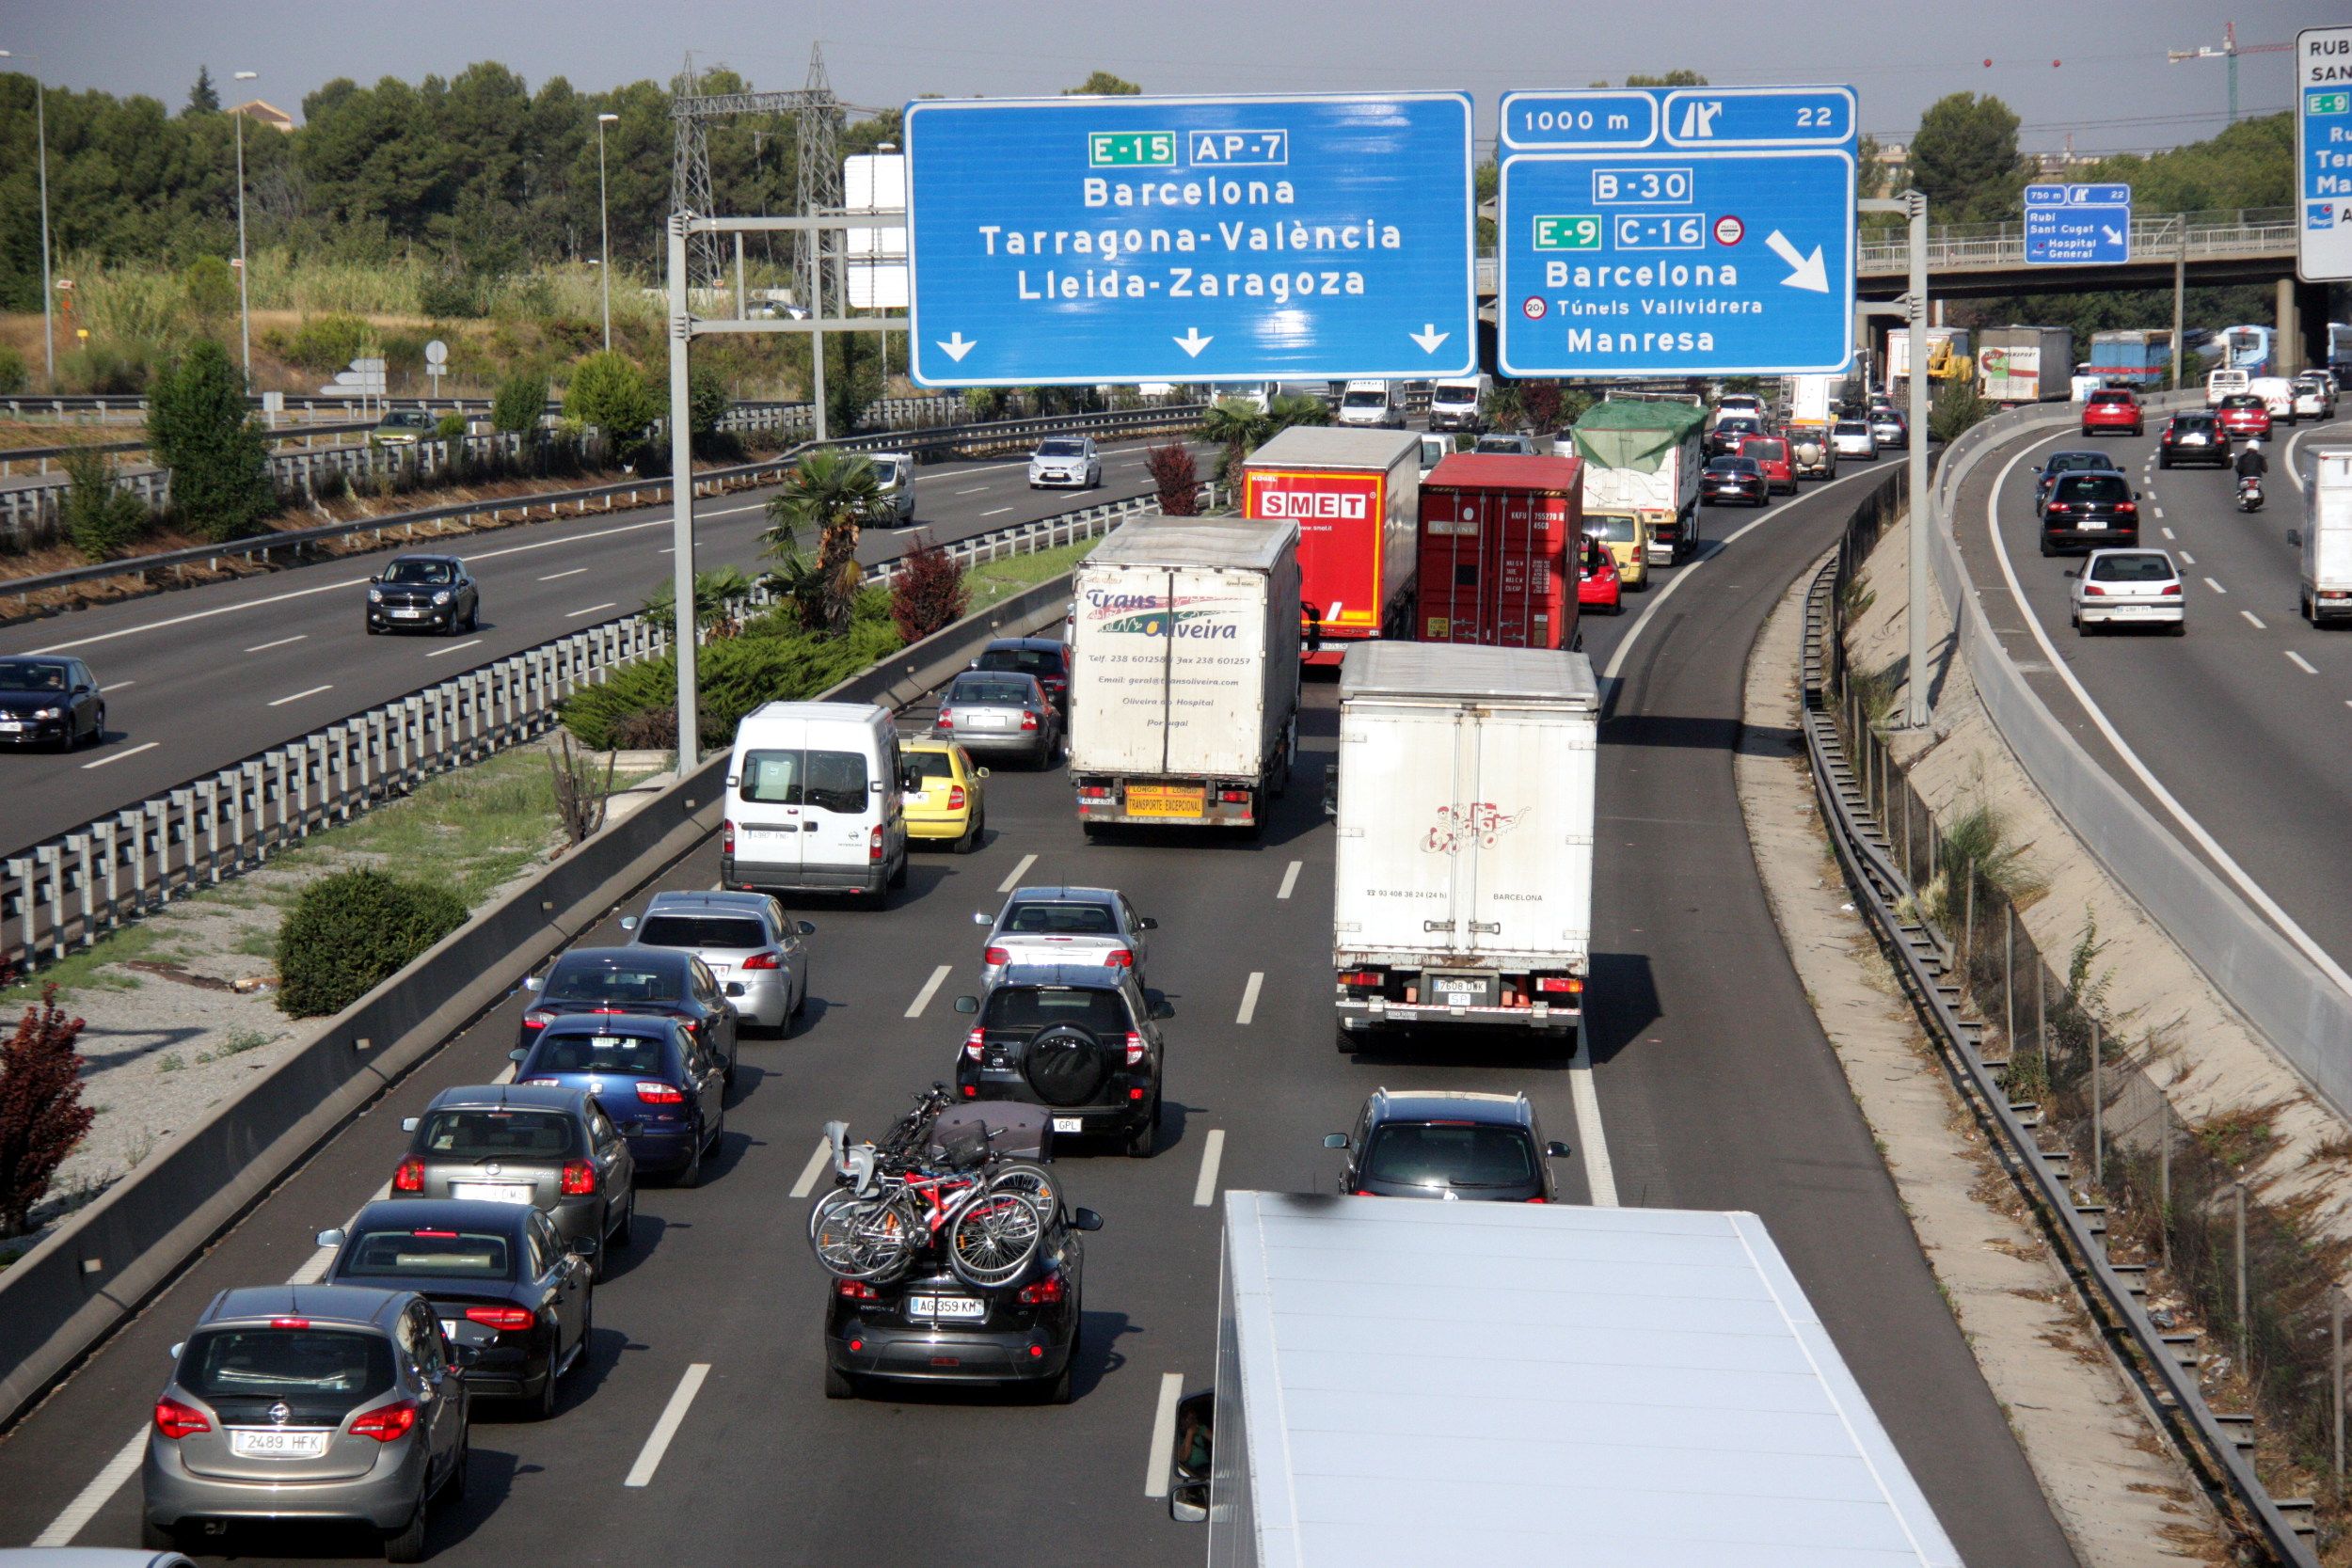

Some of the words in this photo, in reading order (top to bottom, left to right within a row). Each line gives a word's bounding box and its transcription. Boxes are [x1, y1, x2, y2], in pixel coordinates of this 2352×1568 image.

[2310, 96, 2346, 112] E-9
[1525, 111, 1594, 131] 1000
[1608, 115, 1629, 130] m
[1796, 106, 1832, 126] 22
[1093, 136, 1170, 163] E-15
[1196, 135, 1280, 161] AP-7
[1083, 176, 1295, 207] Barcelona
[1599, 174, 1687, 198] B-30
[2110, 191, 2124, 199] 22
[1538, 220, 1597, 245] E-9
[1620, 219, 1700, 244] C-16
[2030, 225, 2057, 234] Sant
[2060, 225, 2094, 236] Cugat
[2049, 239, 2097, 250] Hospital
[2049, 249, 2093, 259] General
[1546, 260, 1738, 288] Barcelona
[1557, 299, 1629, 316] Túnels
[1641, 299, 1763, 315] Vallvidrera
[1567, 328, 1714, 353] Manresa
[1265, 495, 1362, 515] SMET
[1086, 589, 1157, 609] Trans
[1098, 676, 1126, 685] Email:
[1129, 677, 1239, 686] geral@tansoliveira.com
[1122, 697, 1157, 706] Oliveira
[1176, 699, 1215, 707] Hospital
[1147, 719, 1188, 728] Porugal
[1129, 800, 1163, 811] TRANSPORTE
[1165, 800, 1200, 812] EXCEPCIONAL
[1440, 981, 1463, 990] 7608
[1452, 995, 1468, 1004] SP
[1059, 1120, 1076, 1130] GPL
[247, 1435, 283, 1449] 2489
[292, 1435, 319, 1449] HFK
